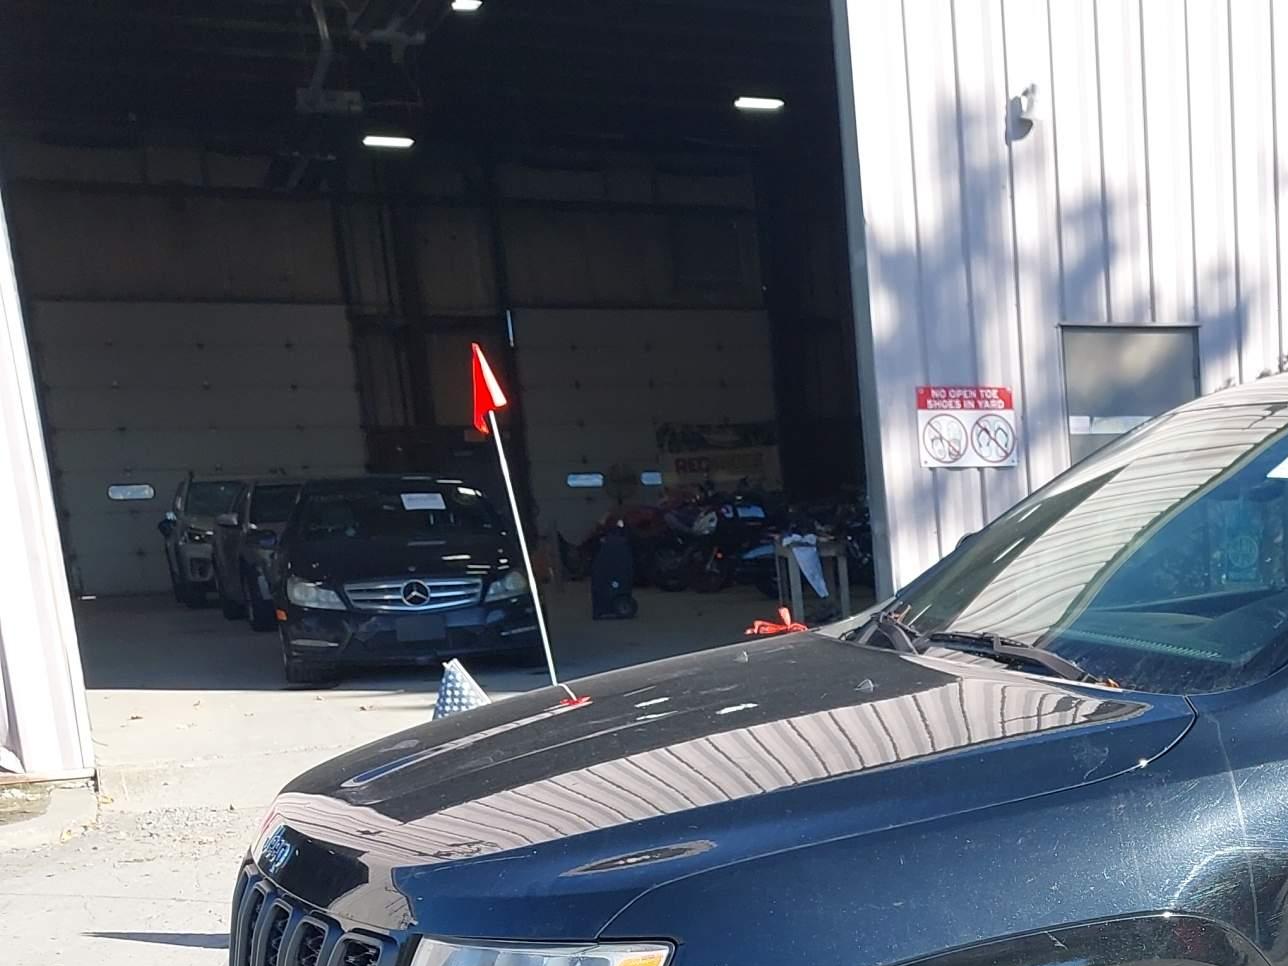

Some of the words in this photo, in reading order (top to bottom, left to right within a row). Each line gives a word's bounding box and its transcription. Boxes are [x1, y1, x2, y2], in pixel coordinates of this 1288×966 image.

[931, 388, 947, 399] NO
[948, 388, 977, 399] OPEN
[979, 388, 1000, 399] TOE
[926, 399, 962, 410] SHOES
[963, 399, 975, 410] IN
[976, 399, 1005, 410] YARD
